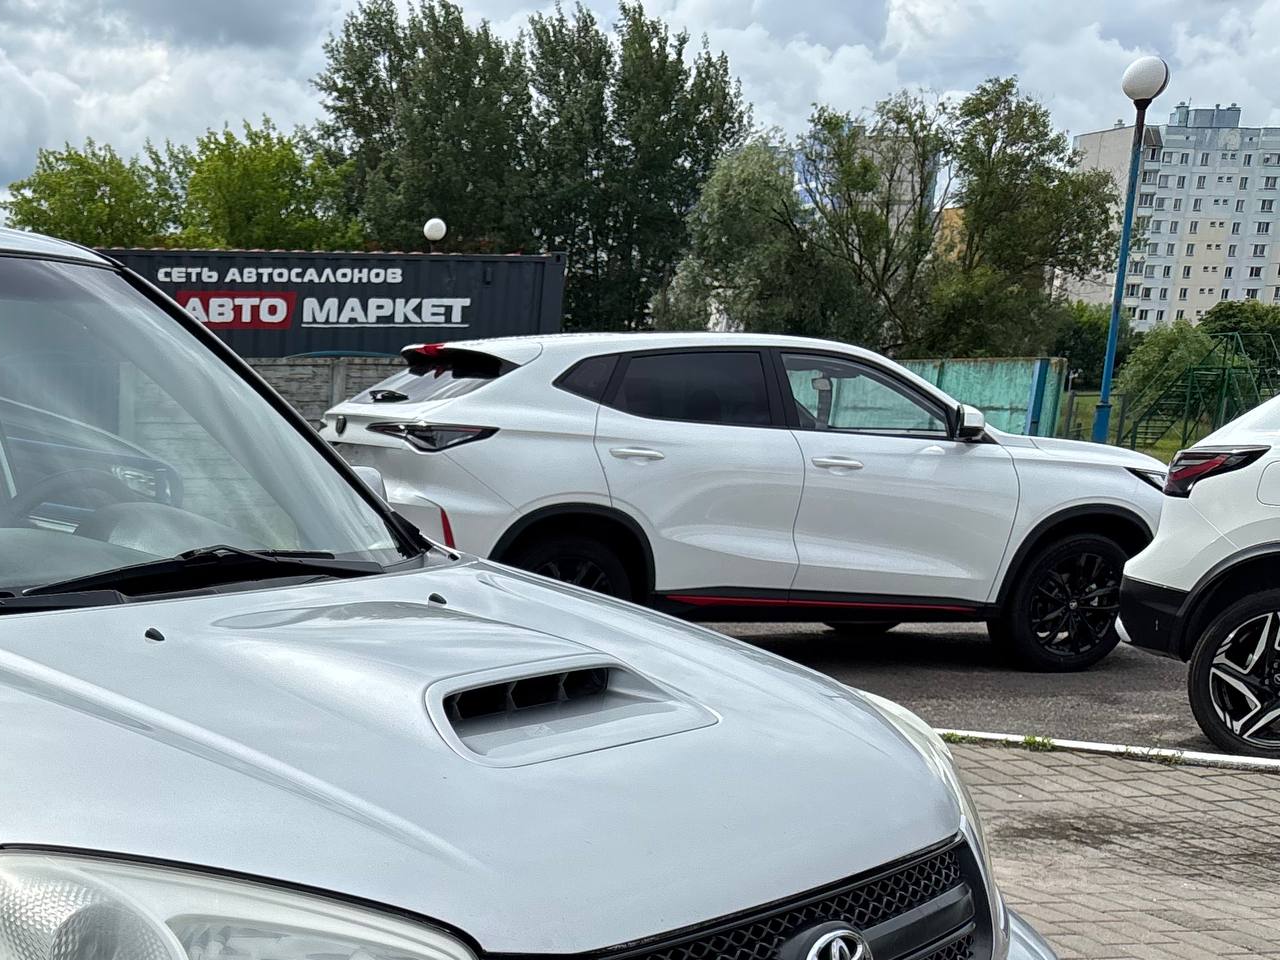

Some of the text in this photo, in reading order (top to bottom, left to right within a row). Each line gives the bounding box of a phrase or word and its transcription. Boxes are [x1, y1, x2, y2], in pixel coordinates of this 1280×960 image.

[157, 267, 403, 283] СЕТЬ АВТОСАЛОНОВ
[185, 297, 471, 323] АВТО МАРКЕТ
